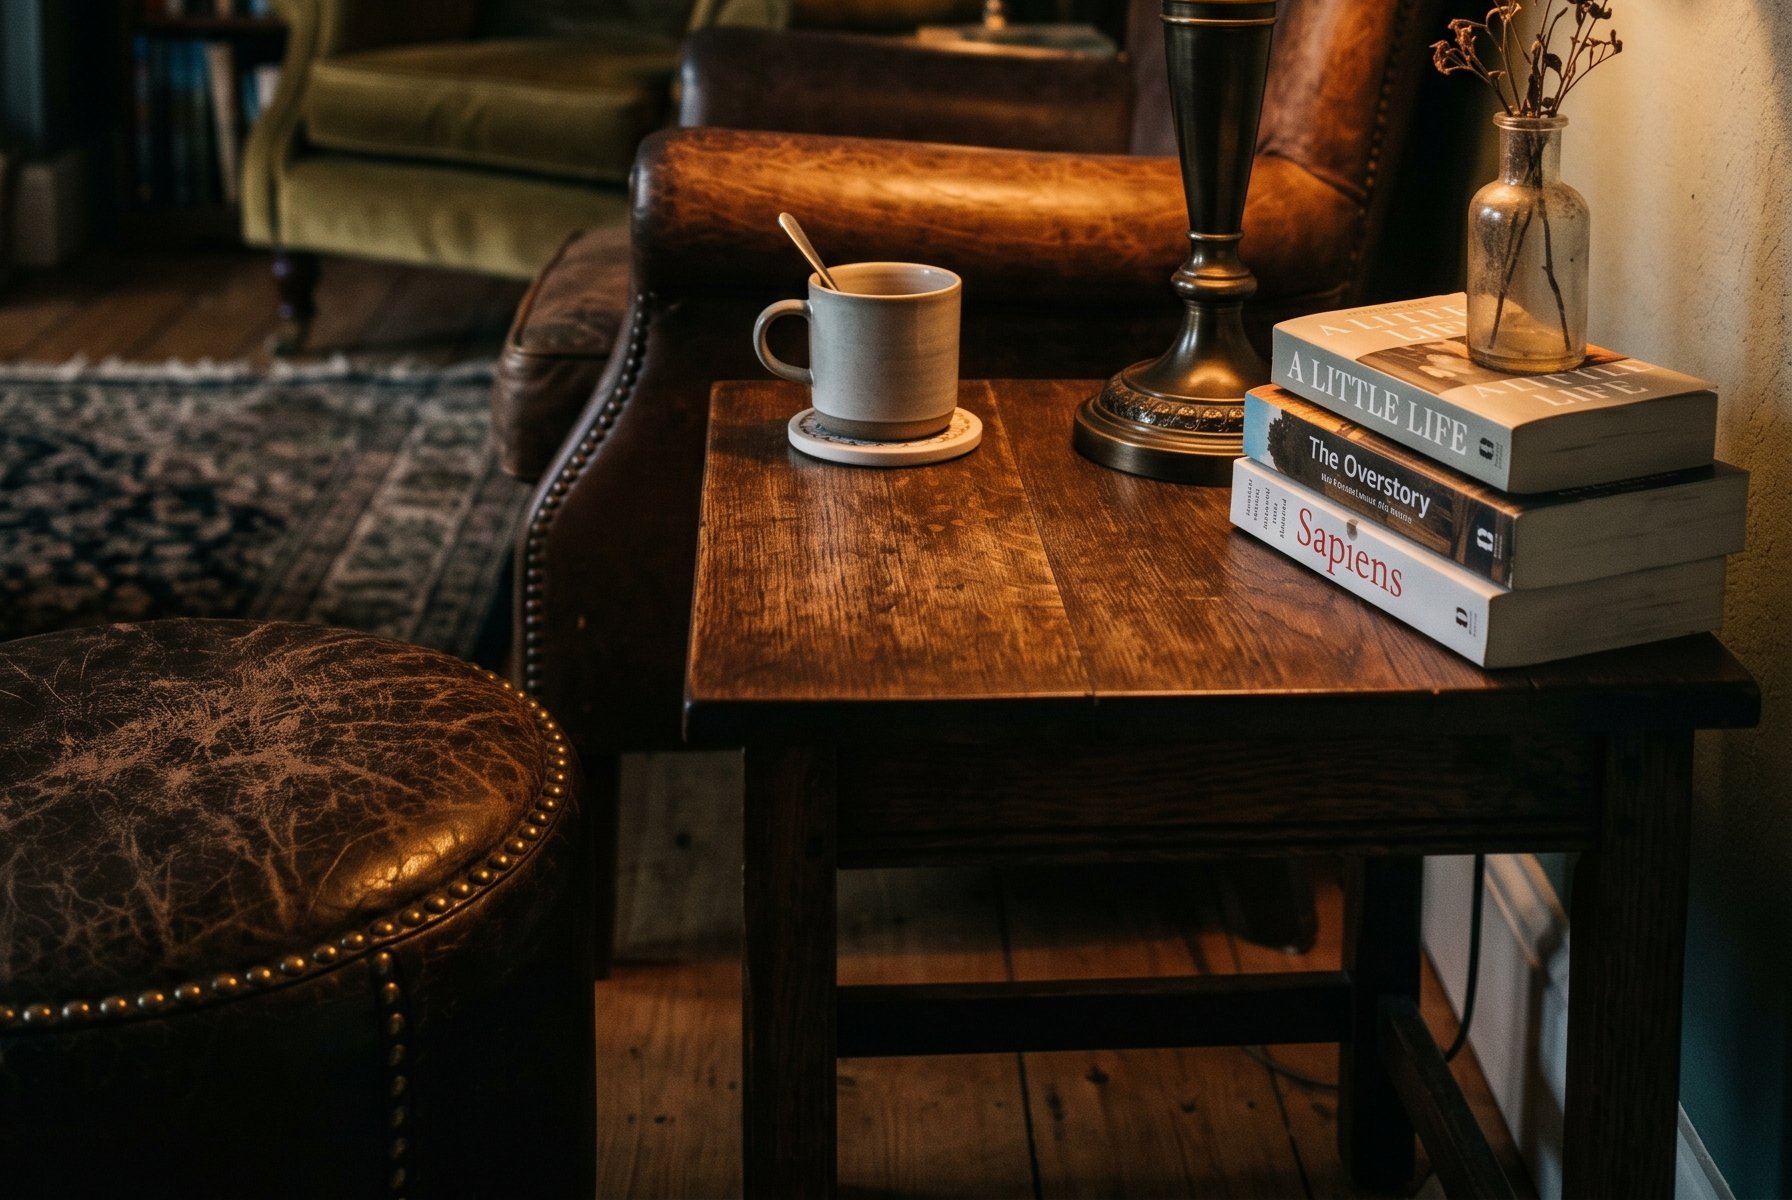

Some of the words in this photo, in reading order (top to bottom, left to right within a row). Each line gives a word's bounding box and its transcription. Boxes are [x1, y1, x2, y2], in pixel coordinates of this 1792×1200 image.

[1287, 351, 1304, 384] A
[1311, 358, 1399, 426] LITTLE
[1406, 400, 1468, 456] LIFE
[1533, 380, 1649, 407] LIFE
[1309, 435, 1338, 470] The
[1344, 454, 1431, 518] Overstory
[1297, 507, 1402, 598] Sapiens
